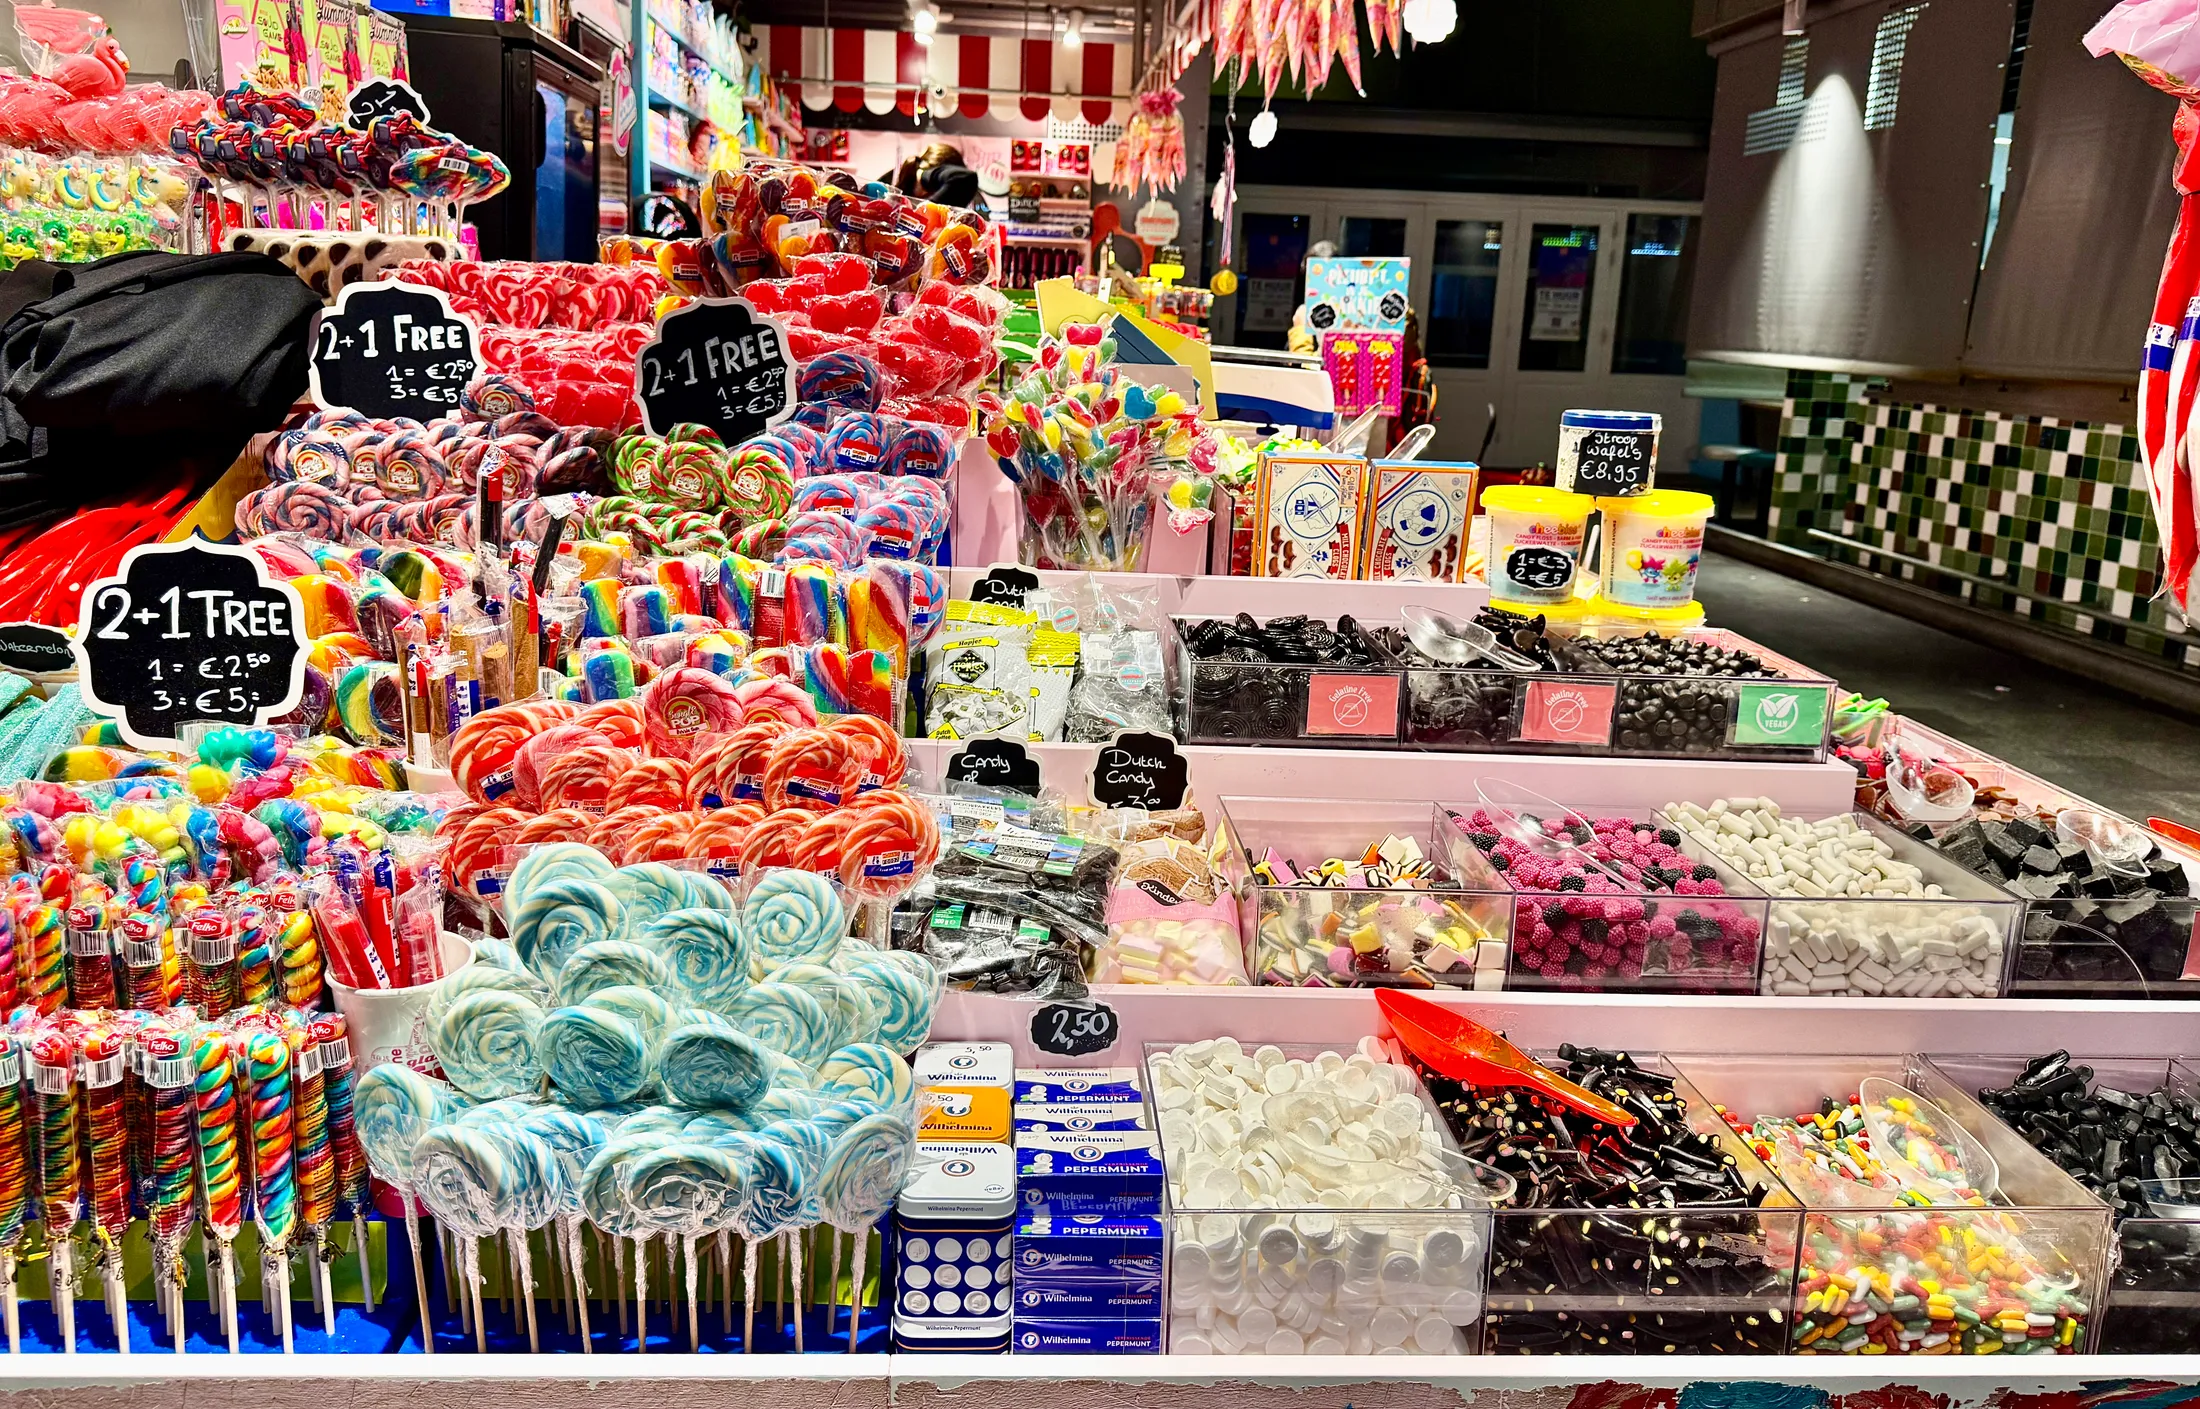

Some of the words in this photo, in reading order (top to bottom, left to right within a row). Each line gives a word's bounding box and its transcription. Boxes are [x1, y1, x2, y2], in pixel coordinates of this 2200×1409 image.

[320, 319, 379, 360] 2+1
[393, 314, 463, 352] FREE
[643, 348, 698, 397] 2+1
[704, 329, 779, 379] FREE
[1332, 548, 1340, 567] CLOGS
[1374, 537, 1387, 569] CHOCOLATE
[1384, 552, 1393, 571] CLOGS
[97, 586, 191, 640] 2+1
[188, 590, 290, 639] FREE
[1328, 685, 1358, 702] Gelatine
[1358, 686, 1373, 703] Free
[1544, 690, 1575, 706] Gelatine
[1575, 692, 1589, 708] Free
[671, 715, 700, 728] POP
[1764, 719, 1788, 728] VEGAN
[1105, 750, 1166, 769] Dutch
[191, 923, 217, 931] Felko
[1050, 1009, 1110, 1050] 2,50
[106, 1036, 123, 1049] Felko
[150, 1041, 175, 1050] Felko
[920, 1123, 992, 1131] Wilhelmina
[1050, 1135, 1123, 1143] Wilhelmina
[922, 1146, 997, 1154] Wilhelmina
[1064, 1165, 1148, 1173] PEPERMUNT
[1045, 1192, 1094, 1200] Wilhelmina
[1063, 1227, 1149, 1235] PEPERMUNT
[1043, 1253, 1093, 1261] Wilhelmina
[1043, 1294, 1093, 1302] Wilhelmina
